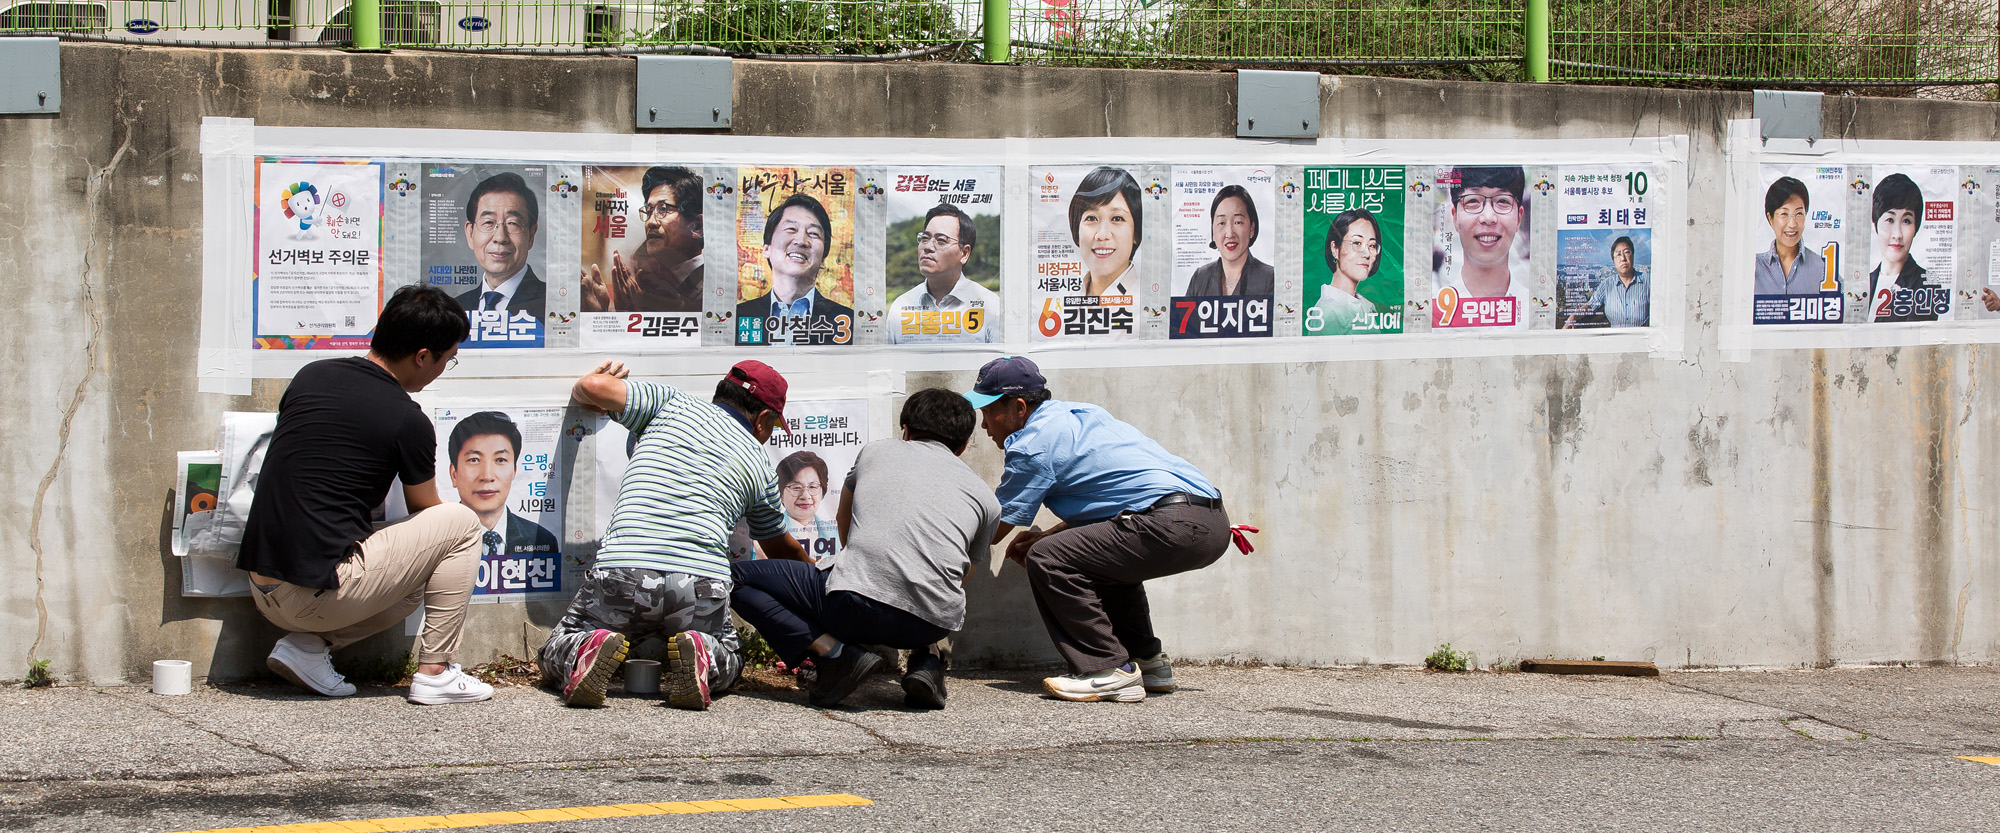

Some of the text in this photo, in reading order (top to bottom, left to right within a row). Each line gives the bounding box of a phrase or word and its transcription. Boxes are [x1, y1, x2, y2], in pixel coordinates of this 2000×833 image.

[812, 173, 847, 196] 서울
[952, 179, 977, 192] 서울
[1307, 168, 1403, 190] 페미니스트
[1564, 171, 1648, 196] 지속 가능한 녹색 청정 10
[1040, 185, 1058, 193] 민중당
[1564, 186, 1613, 196] 서울특별시장 후보
[938, 194, 993, 204] 제1야당 교체!
[1306, 192, 1386, 214] 서울시장
[594, 199, 629, 216] 바꾸자
[326, 214, 361, 227] 훼손하면
[1598, 208, 1647, 226] 최태현
[1833, 218, 1841, 229] 힘
[331, 228, 361, 240] 안 돼요!
[592, 215, 628, 239] 서울
[268, 249, 370, 266] 선거벽보 주의문
[428, 265, 477, 275] 시대와 나란히
[1038, 262, 1082, 276] 비정규직
[1820, 242, 1840, 292] 1
[428, 276, 477, 285] 시민과 나란히
[1037, 278, 1083, 292] 서울시장
[970, 300, 984, 308] 정의당
[1065, 297, 1081, 305] 유일한
[1082, 297, 1099, 305] 노동자
[1436, 287, 1457, 326] 9
[1461, 299, 1513, 325] 우인철
[1877, 288, 1951, 317] 2 홍인정
[1038, 297, 1134, 338] 6 김진숙
[1175, 298, 1268, 334] 7 인지연
[1789, 298, 1841, 321] 김미경
[627, 313, 642, 333] 2
[642, 316, 699, 337] 김문수
[739, 318, 762, 330] 서울
[900, 310, 979, 335] 김종민 5
[1305, 306, 1401, 332] 8 신지예
[739, 332, 762, 342] 살림
[765, 314, 852, 344] 안철수 3
[804, 415, 848, 430] 은평살림
[770, 432, 862, 448] 바꿔야 바뀝니다.
[543, 472, 556, 480] 키운
[528, 482, 546, 497] 1등
[518, 498, 556, 514] 시의원
[474, 557, 556, 590] 이현찬
